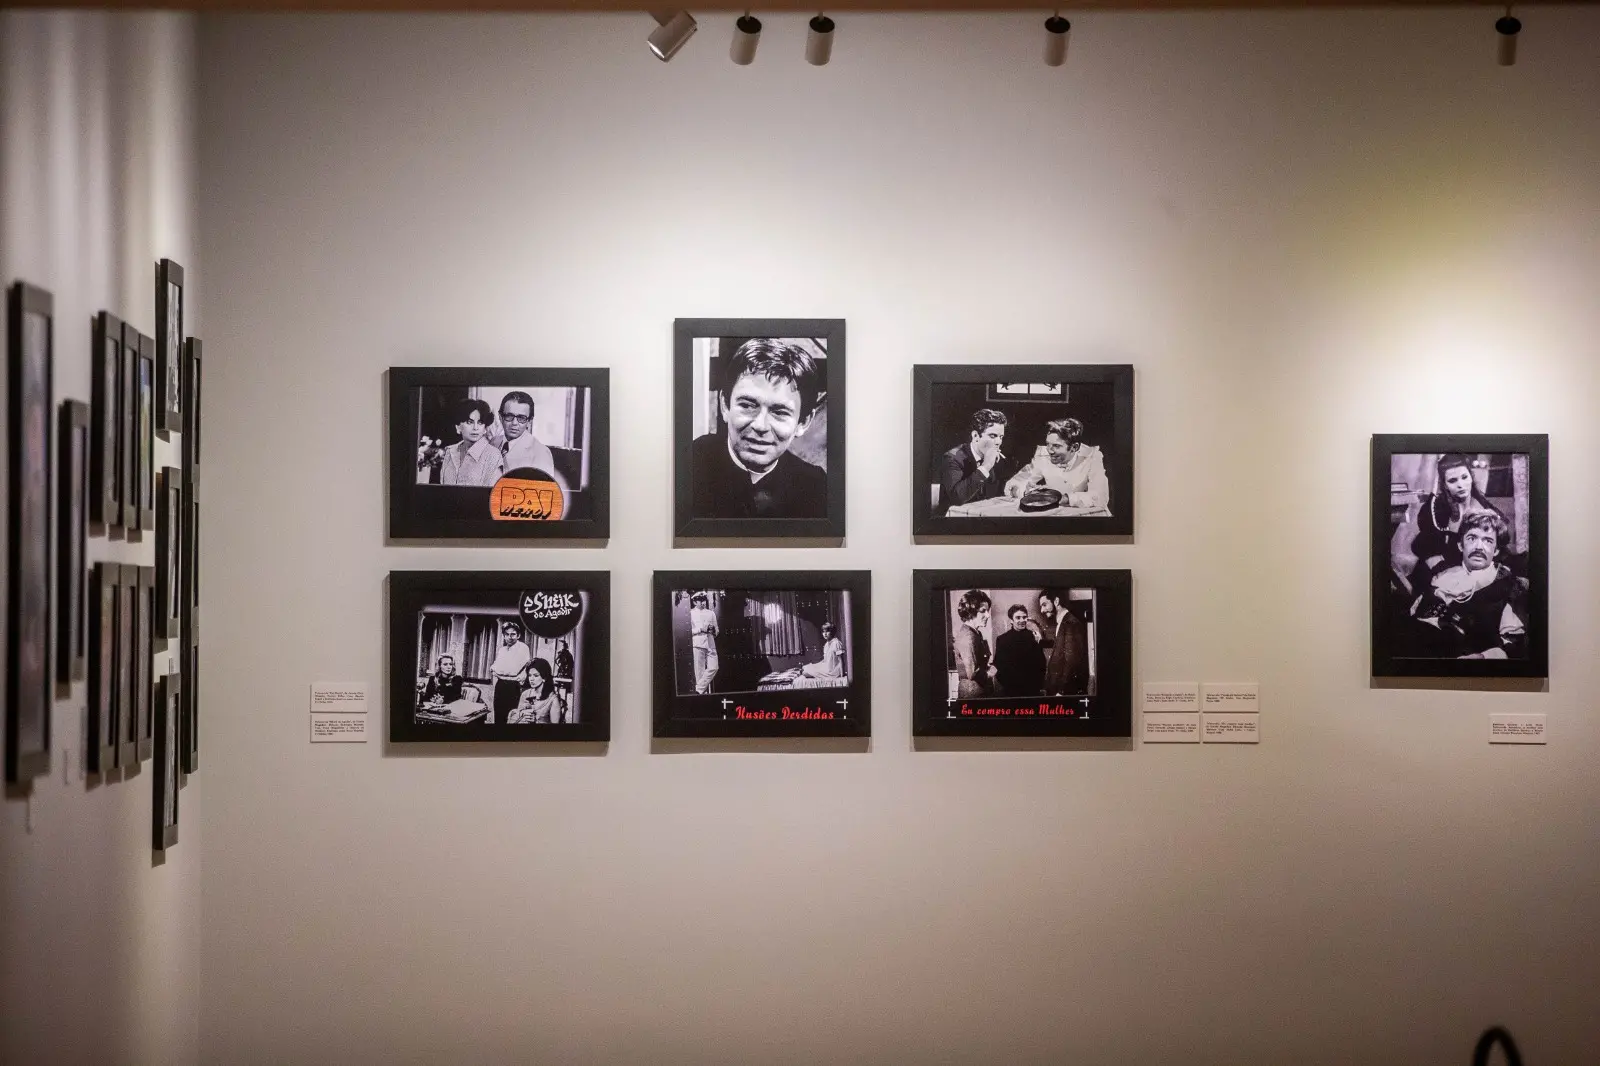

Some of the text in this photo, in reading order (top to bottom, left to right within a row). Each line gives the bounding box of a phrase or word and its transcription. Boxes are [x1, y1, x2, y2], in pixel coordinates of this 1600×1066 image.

[500, 486, 553, 516] PAI
[960, 703, 1075, 717] Eu compro essa Mulher
